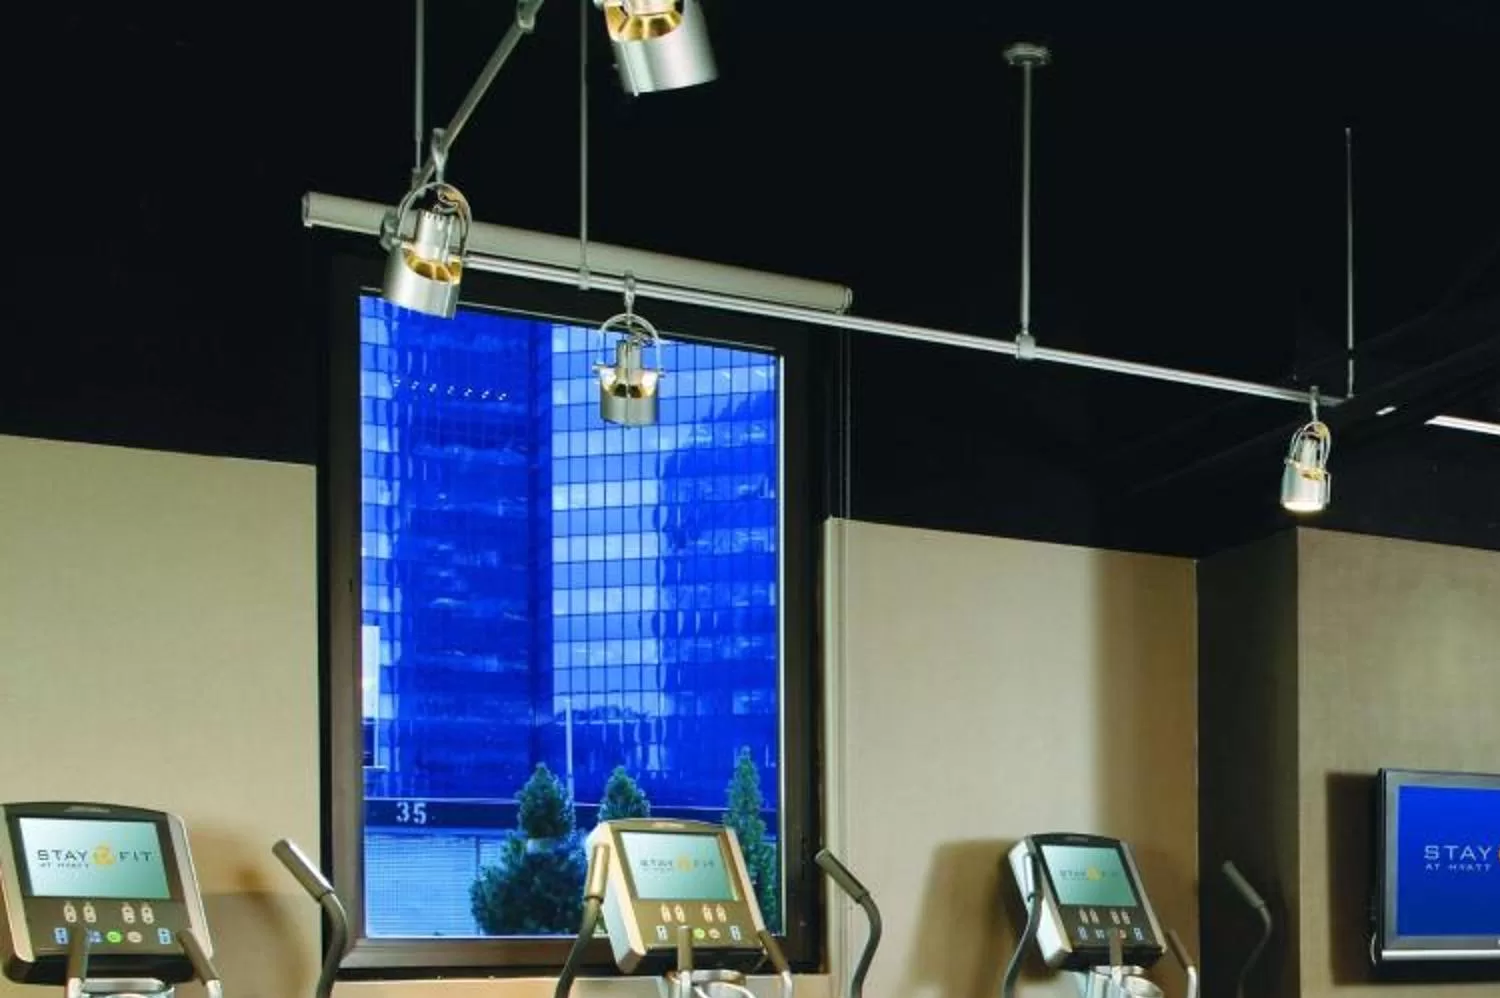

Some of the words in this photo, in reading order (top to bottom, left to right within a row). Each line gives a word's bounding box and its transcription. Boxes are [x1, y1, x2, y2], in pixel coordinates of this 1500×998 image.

[396, 801, 427, 824] 35
[37, 849, 89, 861] STAY
[119, 851, 153, 862] FIT
[1423, 845, 1492, 860] STAY
